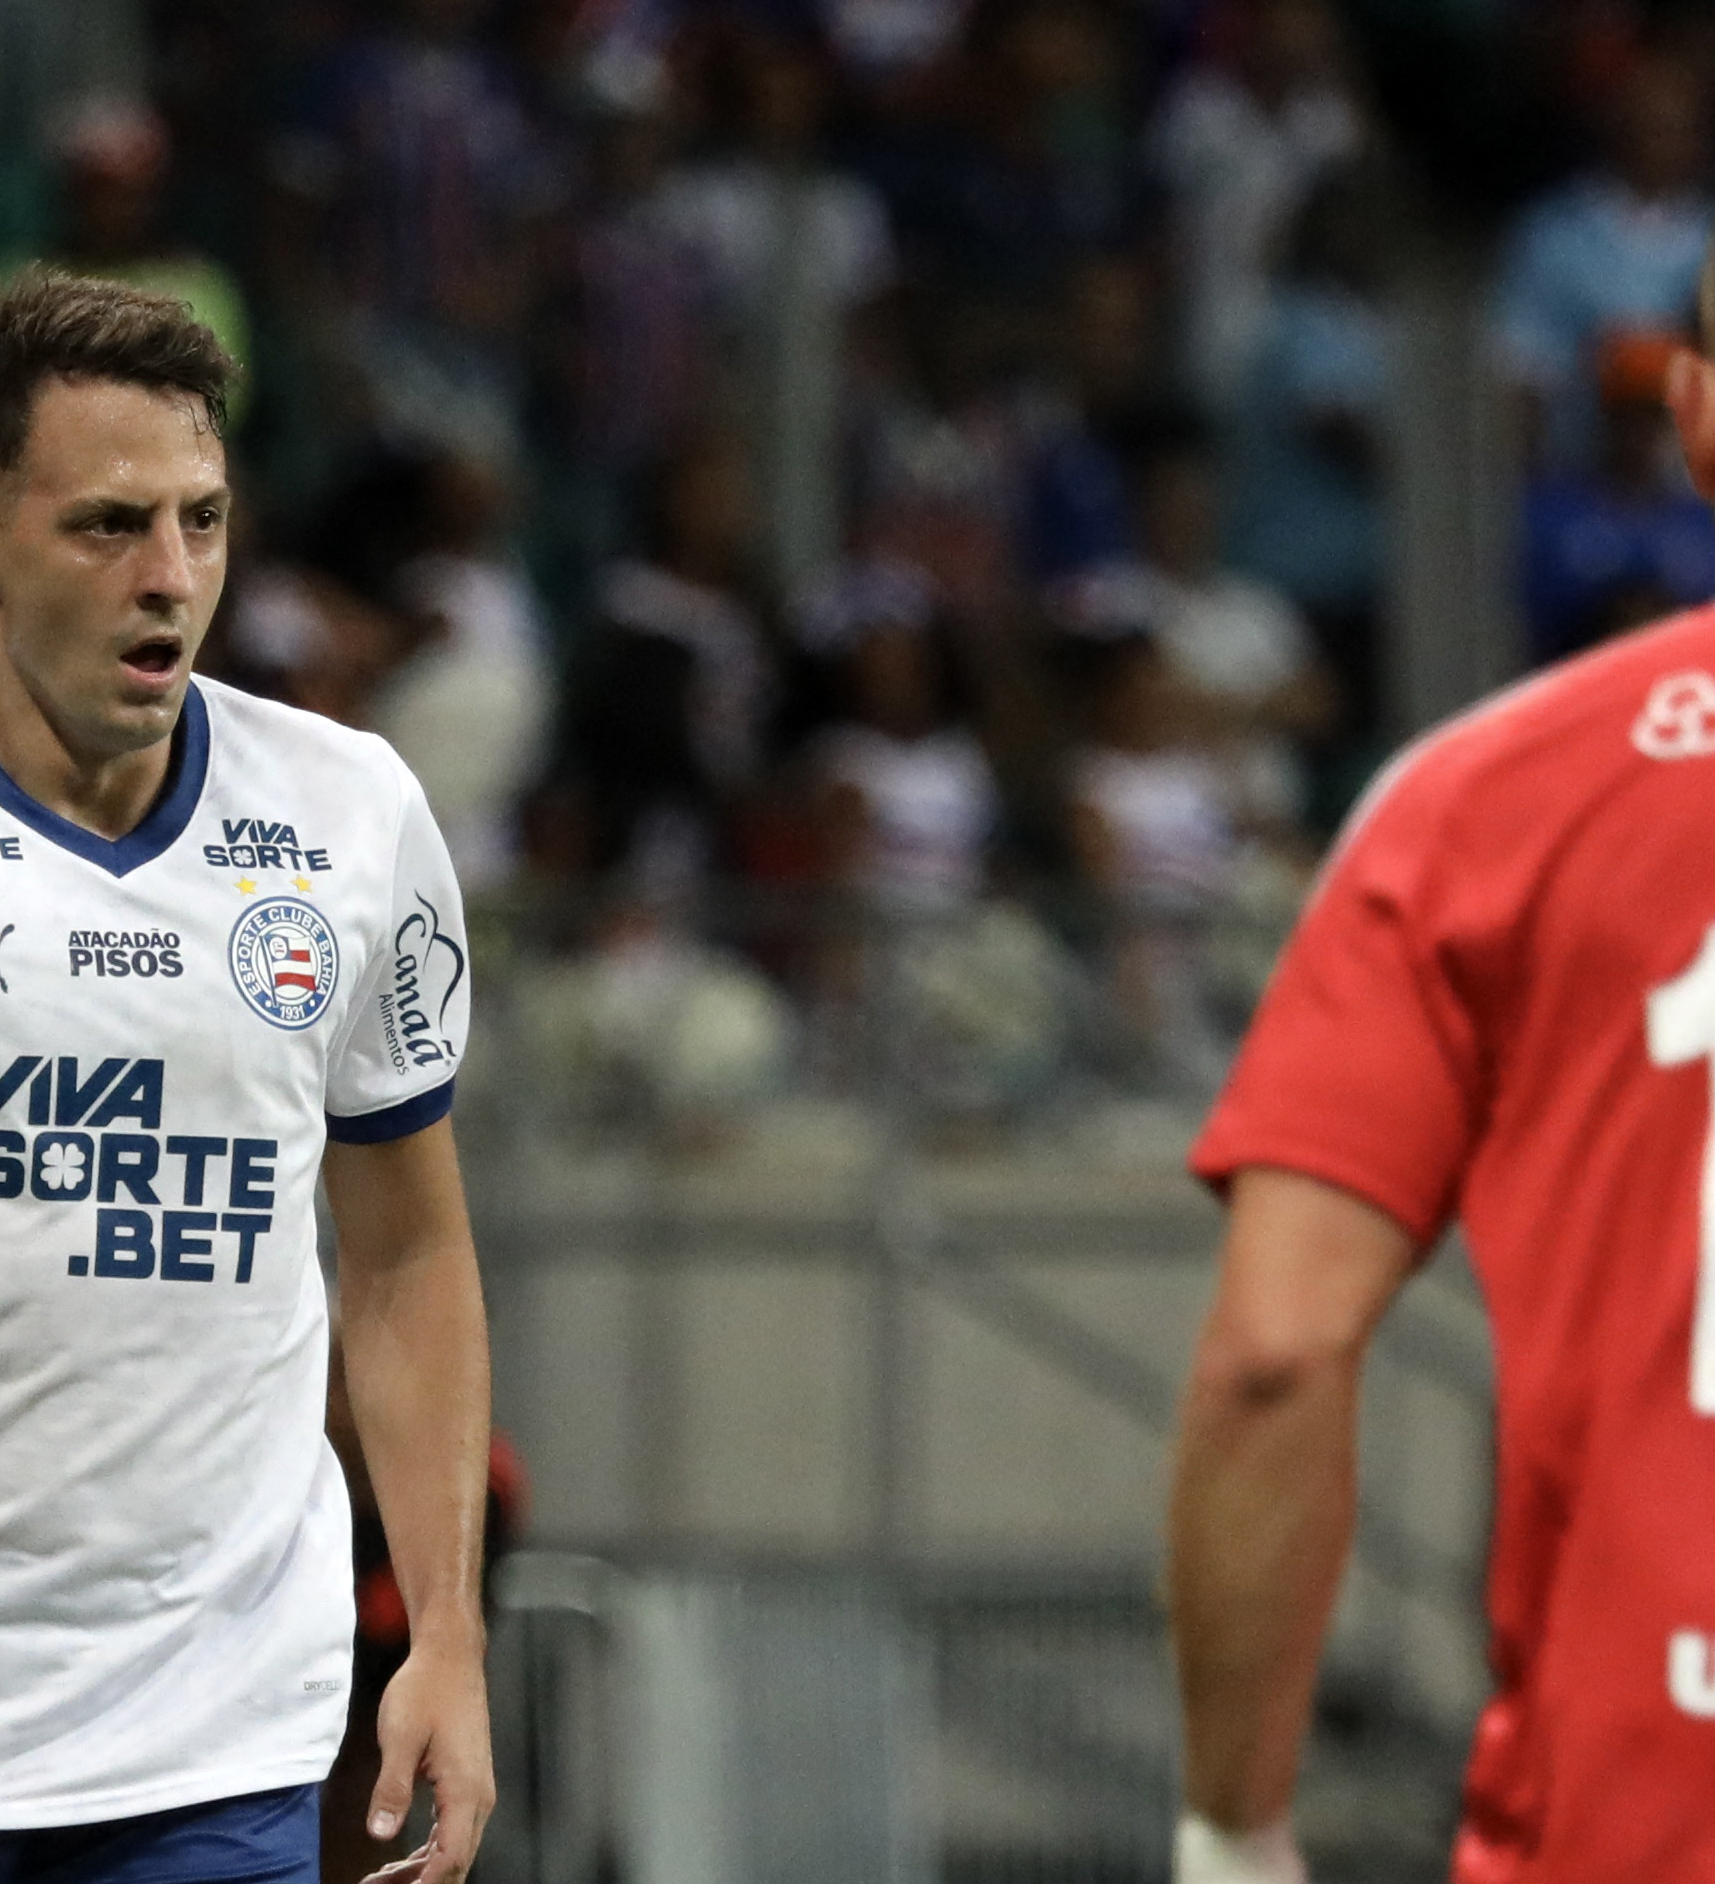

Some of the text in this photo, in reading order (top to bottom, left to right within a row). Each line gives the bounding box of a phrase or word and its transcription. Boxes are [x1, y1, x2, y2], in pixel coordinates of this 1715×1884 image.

[222, 818, 298, 847] VIVA
[203, 844, 331, 871] SORTE
[68, 928, 180, 949] ATACADÃO
[239, 908, 332, 996] ESPORTE CLUBE BAHIA
[69, 949, 184, 978] PISOS
[394, 913, 456, 1067] Canaã
[279, 1005, 305, 1019] 1931
[379, 993, 409, 1076] Alimentos
[67, 1208, 272, 1283] .BET
